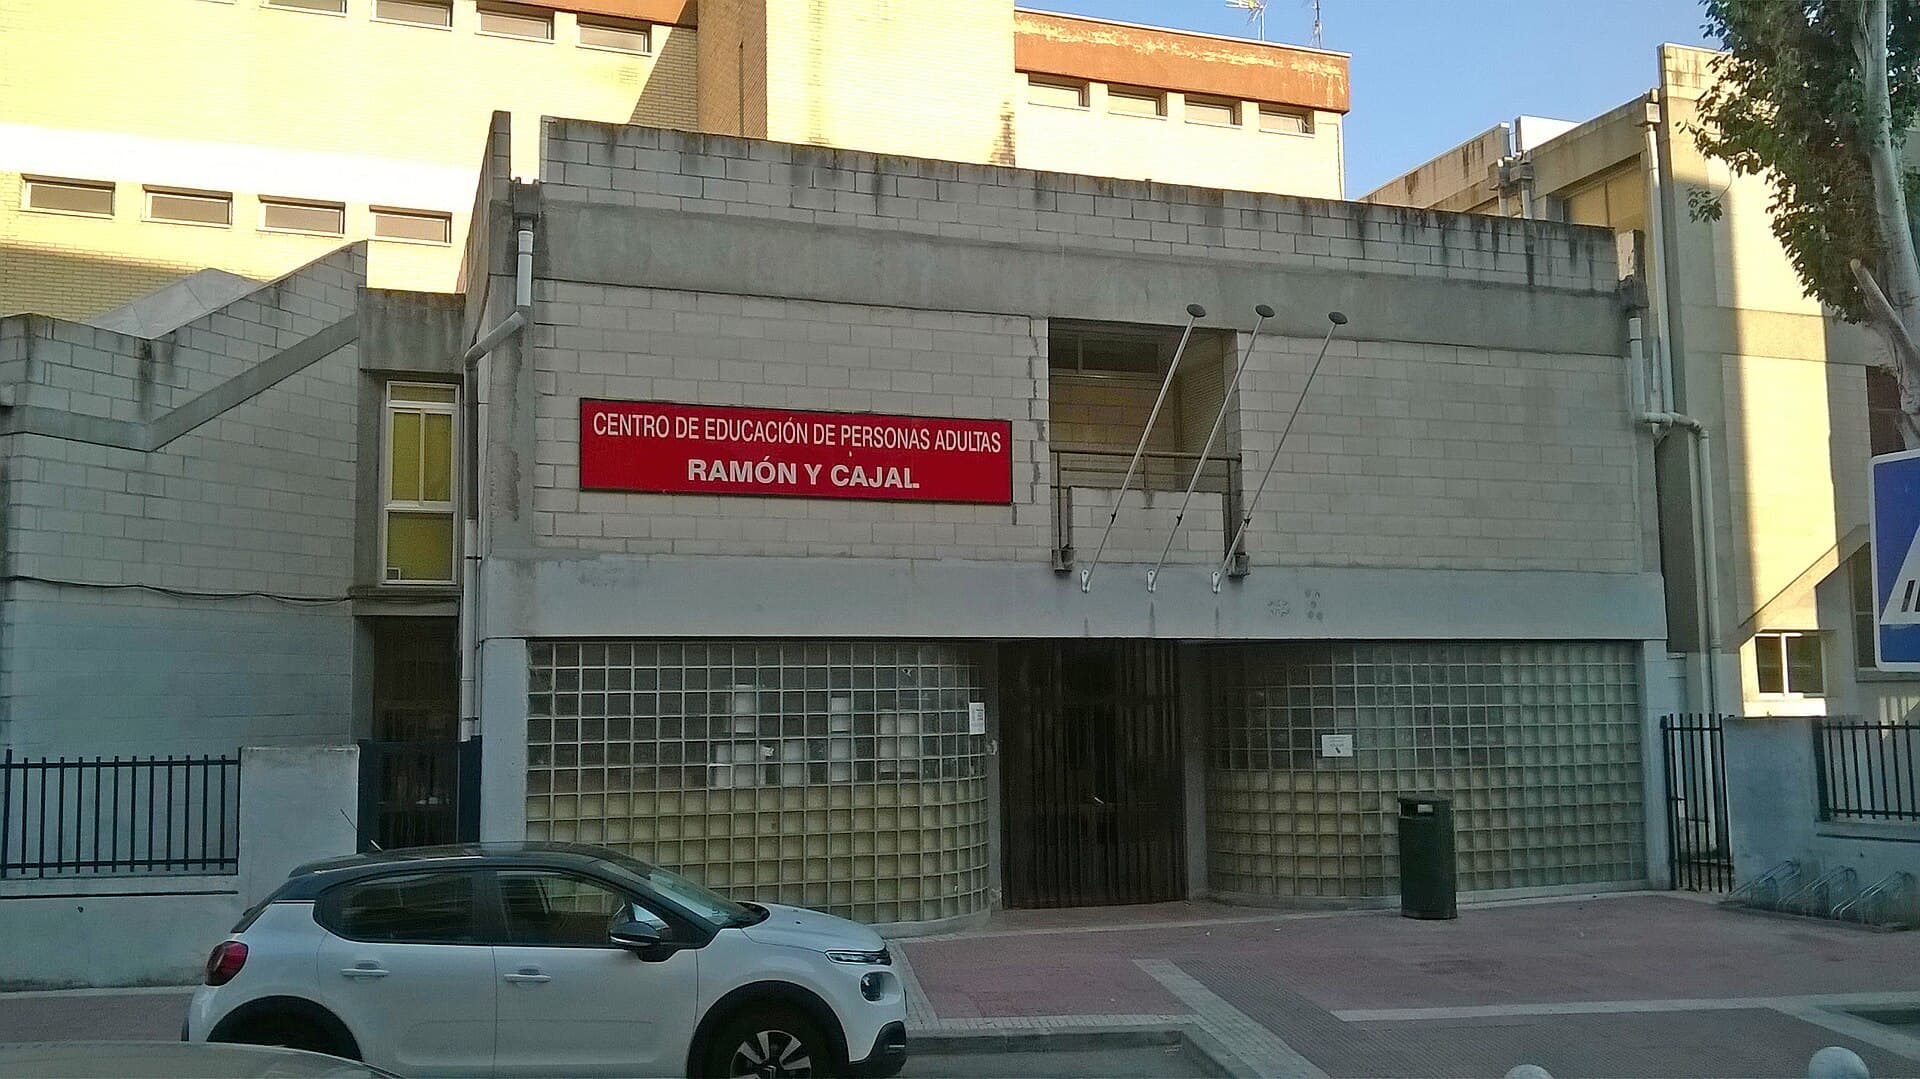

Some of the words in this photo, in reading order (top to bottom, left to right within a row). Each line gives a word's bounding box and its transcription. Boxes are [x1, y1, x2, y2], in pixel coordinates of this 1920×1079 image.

[593, 411, 670, 438] CENTRO
[675, 417, 700, 440] DE
[704, 416, 809, 445] EDUCACIÓN
[813, 423, 836, 446] DE
[840, 424, 931, 450] PERSONAS
[934, 429, 1001, 453] ADULTAS
[688, 455, 797, 485] RAMÓN
[803, 463, 823, 486] Y
[830, 464, 920, 489] CAJAL
